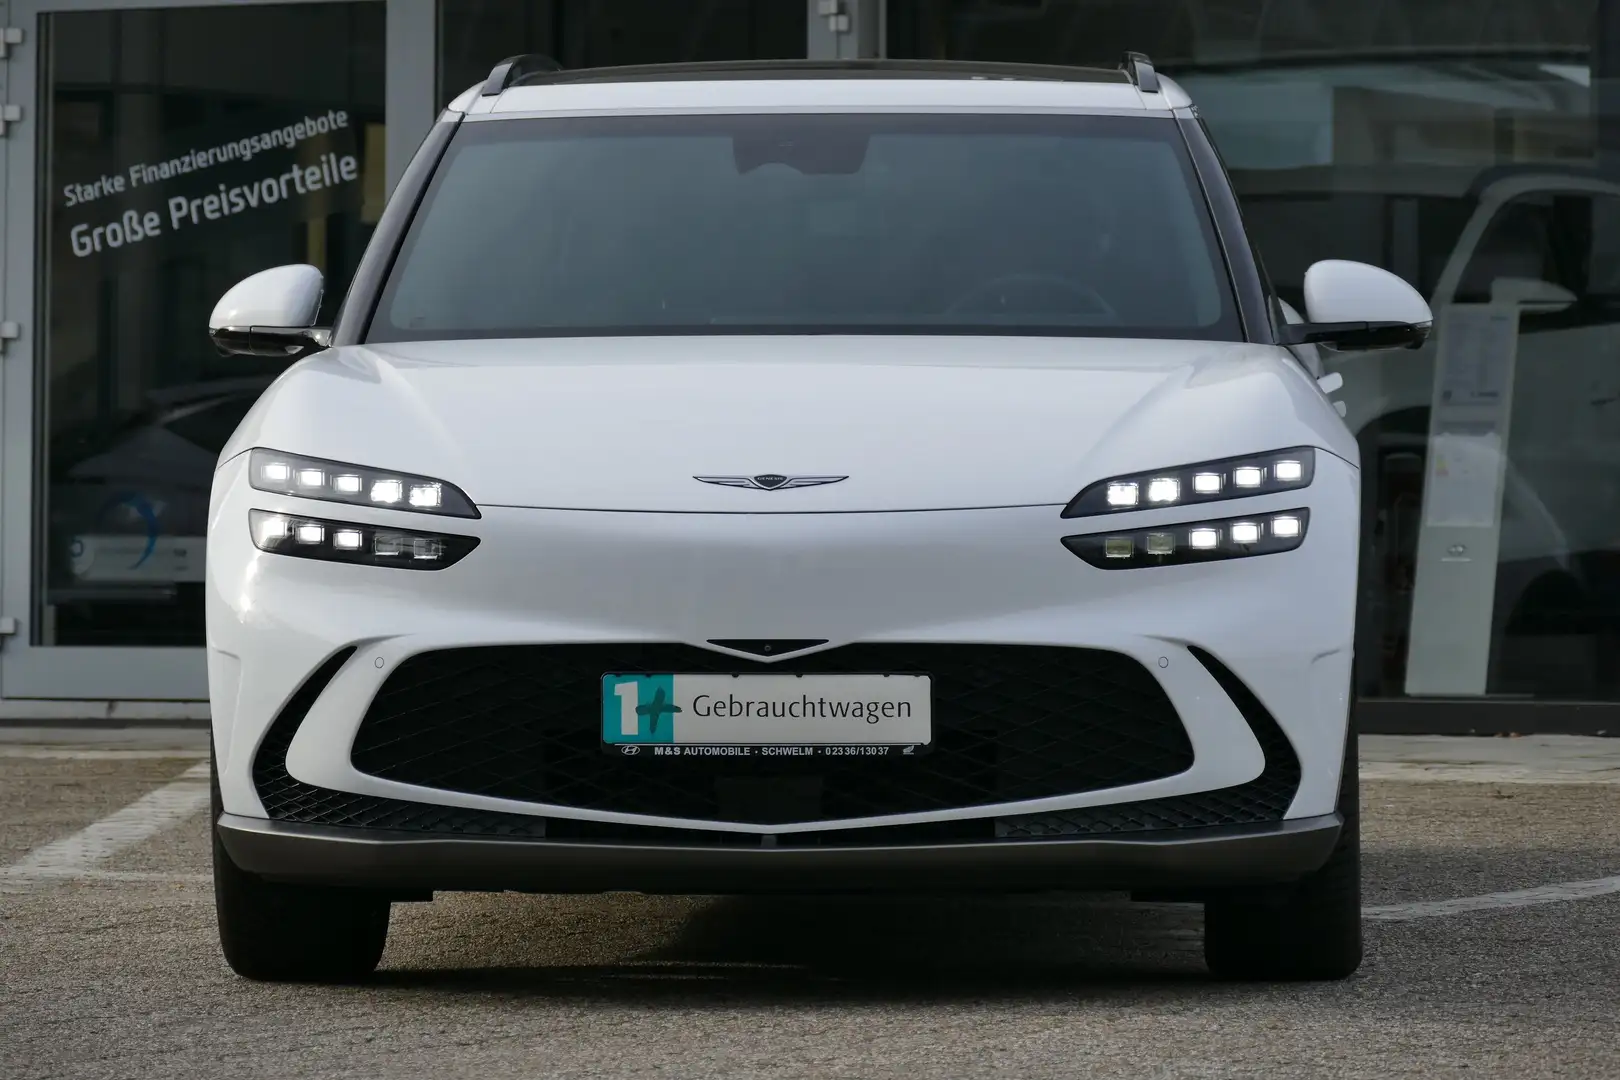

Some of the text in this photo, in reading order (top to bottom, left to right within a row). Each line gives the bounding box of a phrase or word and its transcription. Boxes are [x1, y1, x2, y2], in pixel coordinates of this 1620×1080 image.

[63, 108, 349, 207] Starke Finanzierungsangebote
[70, 152, 359, 258] Große Preisvorteile
[692, 694, 912, 724] Gebrauchtwagen
[654, 745, 889, 756] M&S AUTOMOBILE SCHWELM 02336/13037
